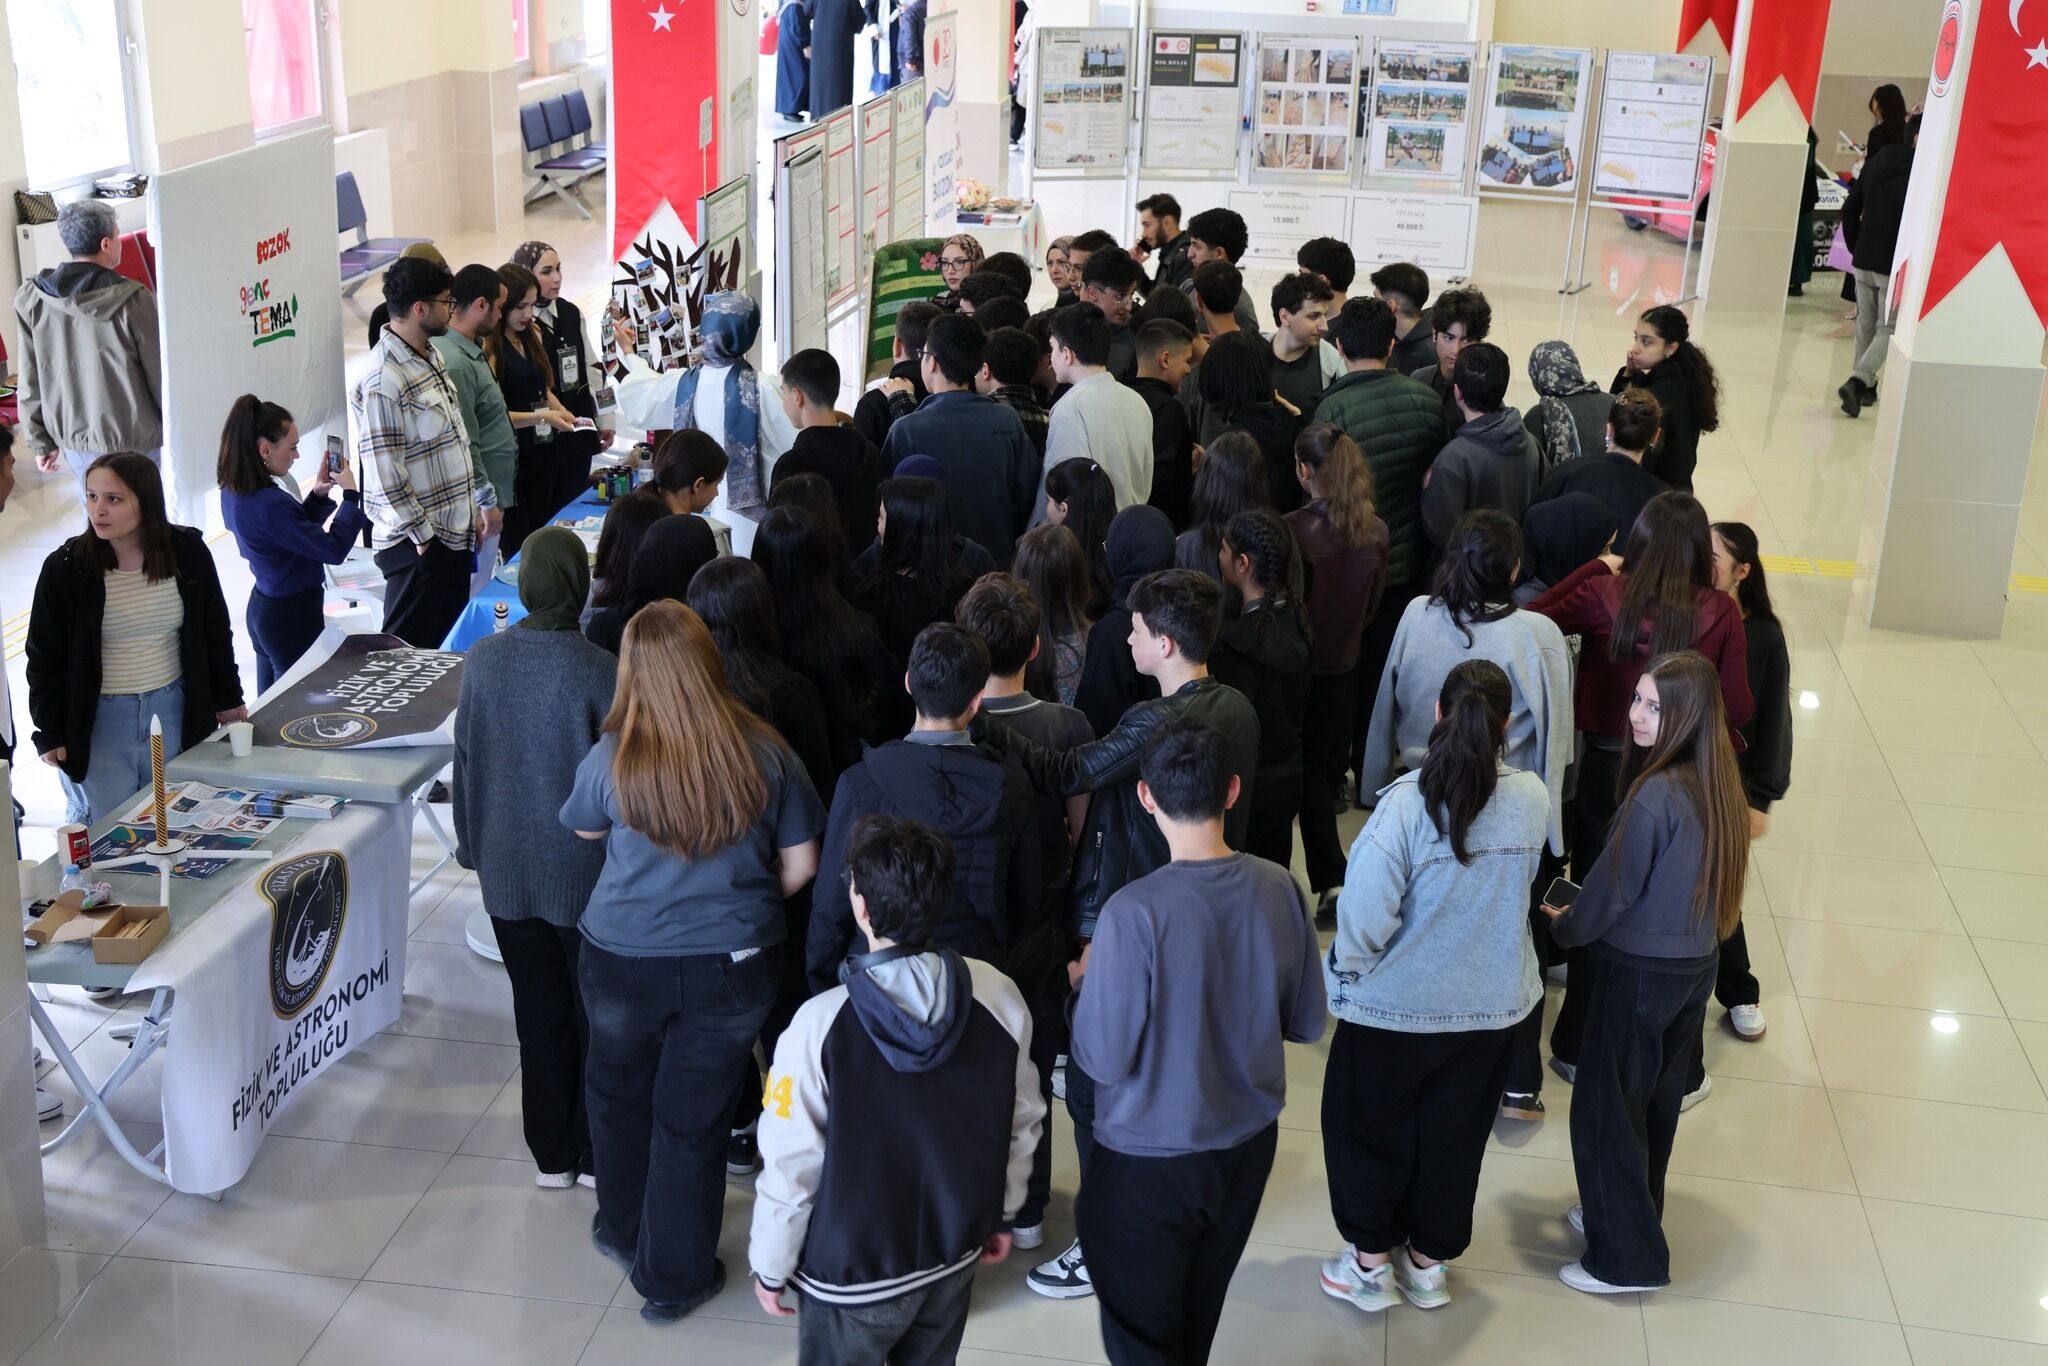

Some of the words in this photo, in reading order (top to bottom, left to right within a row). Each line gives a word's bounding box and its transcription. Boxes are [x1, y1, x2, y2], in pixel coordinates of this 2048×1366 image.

[256, 227, 291, 265] BOZOK
[240, 278, 270, 316] genç
[249, 300, 292, 335] TEMA
[325, 674, 374, 698] FİZİK
[360, 660, 396, 676] VE
[343, 651, 437, 714] ASTRONOMİ
[371, 655, 464, 713] TOPLULUĞU
[271, 857, 320, 893] FİZASTRO
[232, 1068, 263, 1132] FİZİK
[265, 1043, 281, 1081] VE
[284, 949, 389, 1062] ASTRONOMİ
[258, 1020, 349, 1131] TOPLULUĞU
